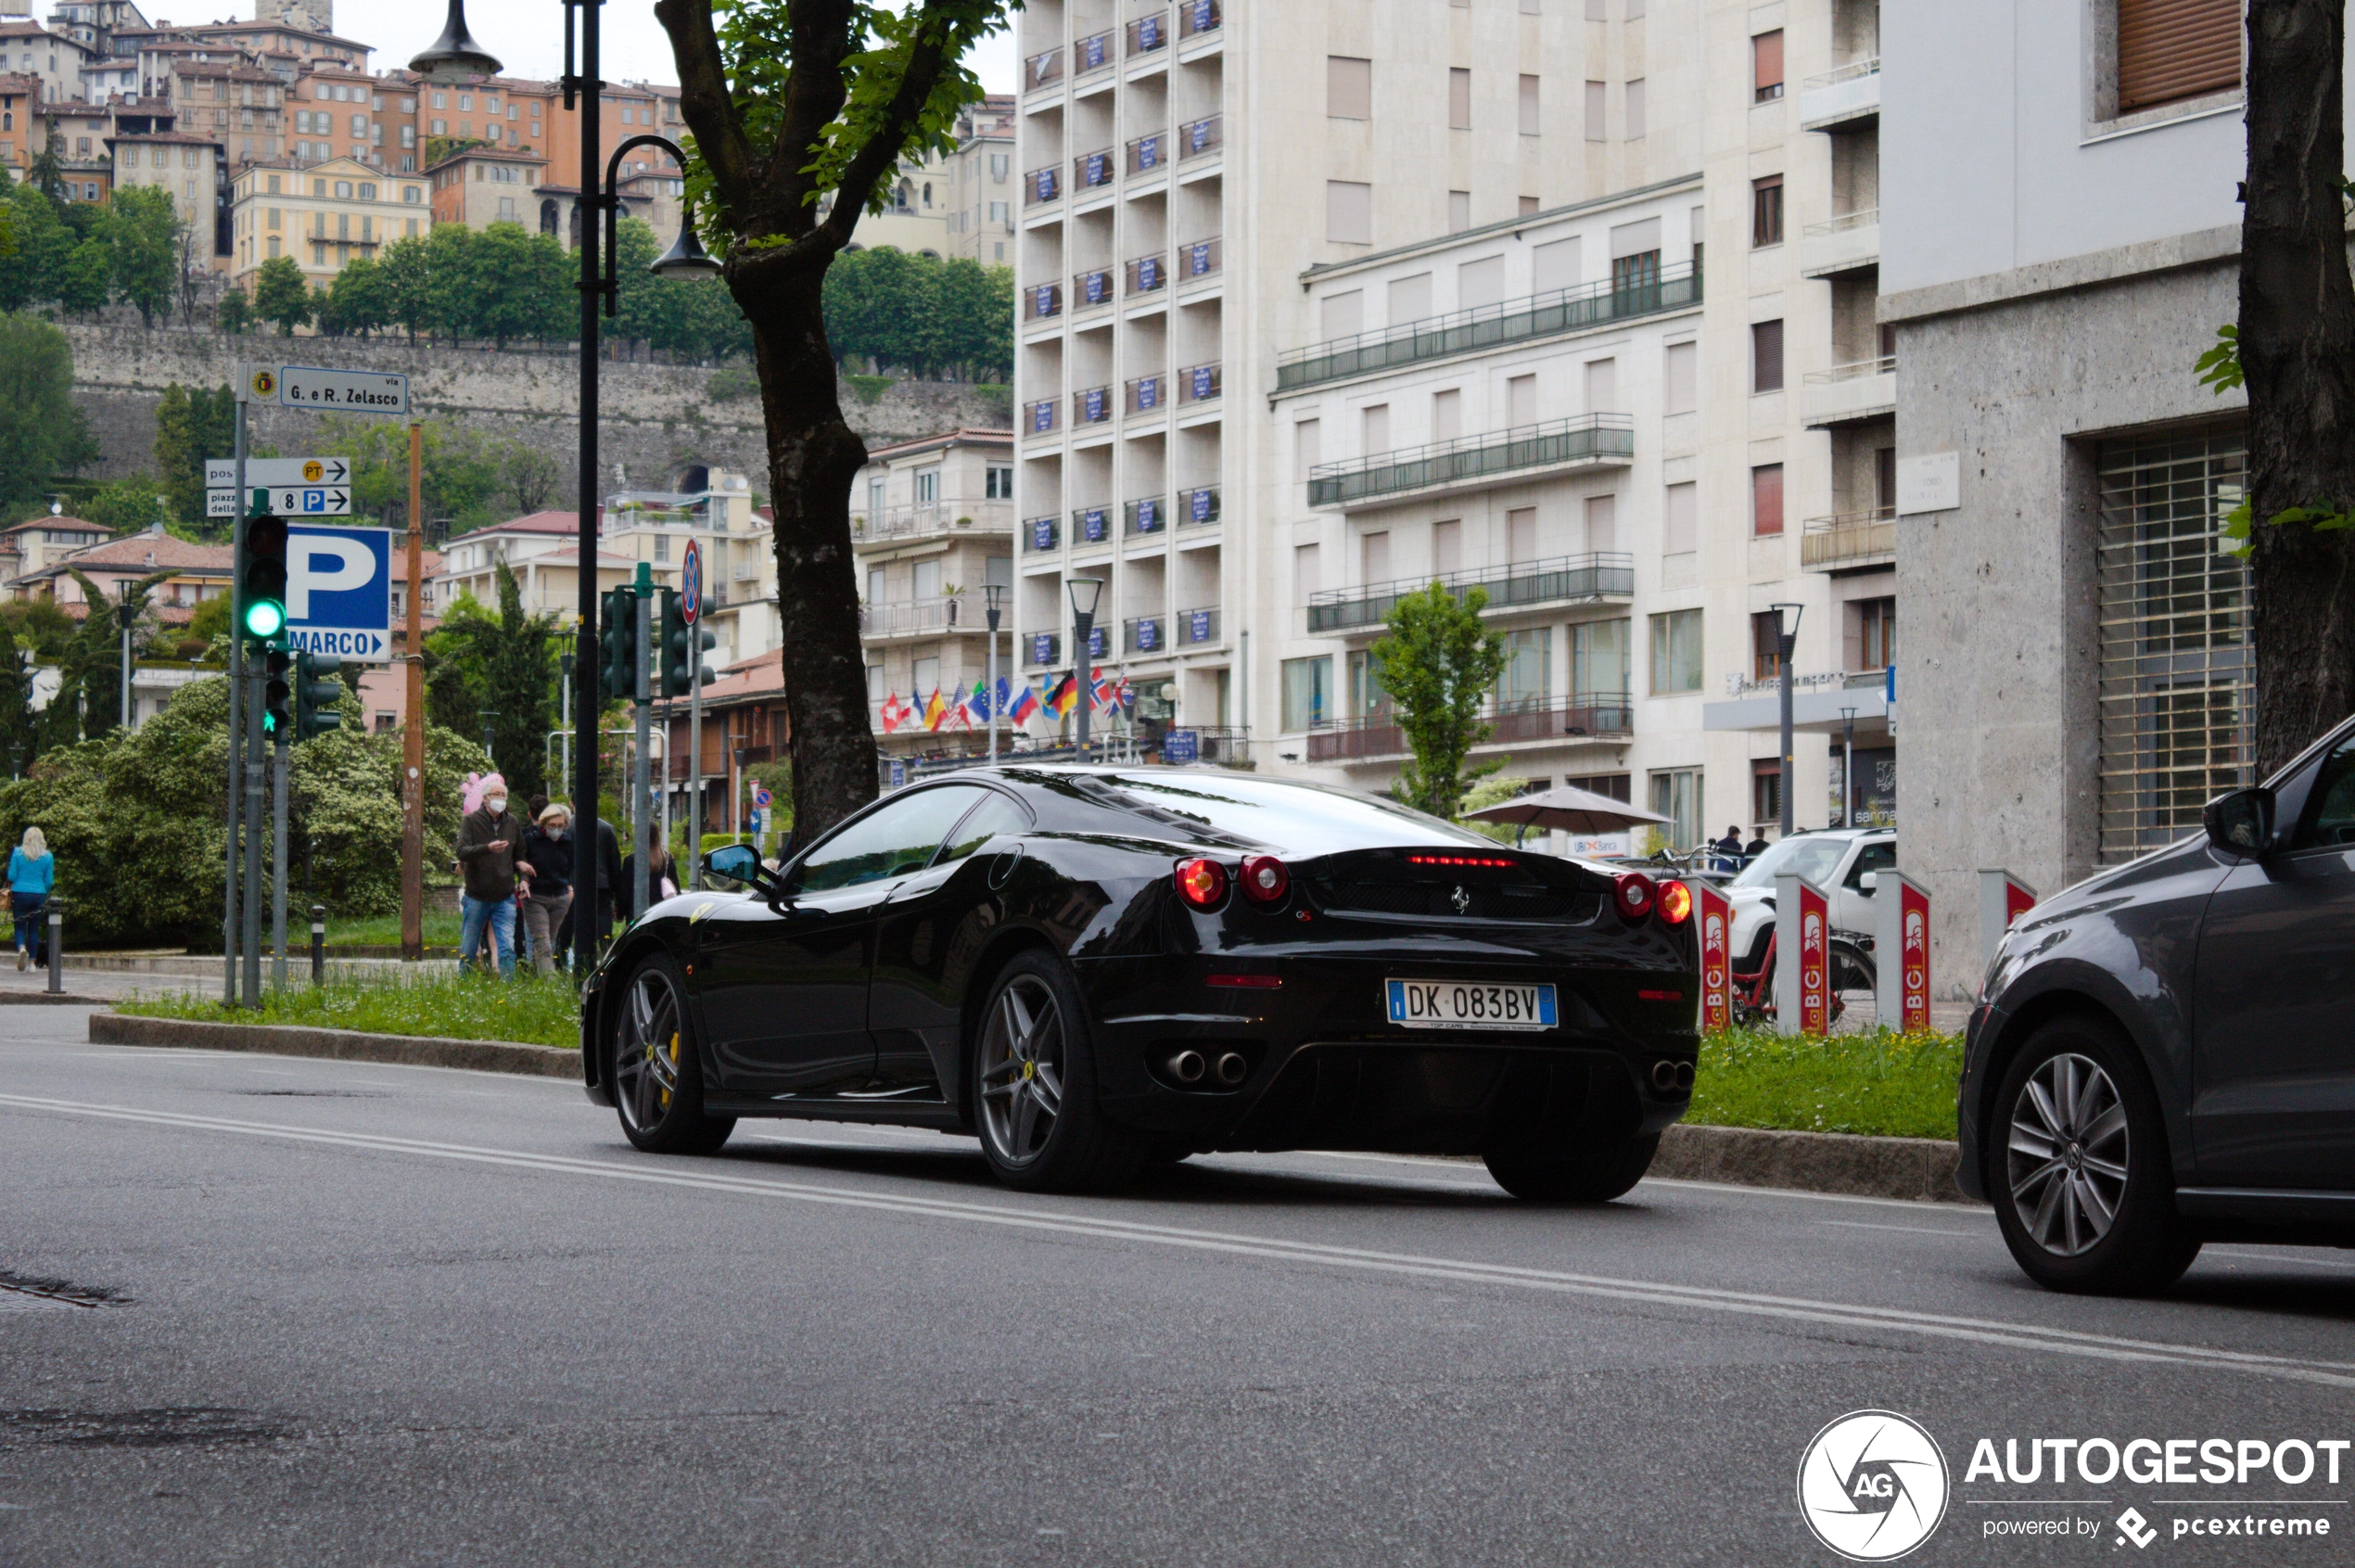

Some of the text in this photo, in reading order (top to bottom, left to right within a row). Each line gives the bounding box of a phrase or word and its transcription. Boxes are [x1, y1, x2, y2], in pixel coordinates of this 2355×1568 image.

[291, 385, 305, 400] G.
[312, 390, 319, 401] e
[325, 389, 340, 402] R.
[347, 389, 399, 405] Zelasco
[305, 467, 322, 477] PT
[211, 492, 245, 504] piazz
[286, 494, 294, 509] 8
[307, 492, 320, 509] P
[211, 504, 236, 513] della
[286, 534, 376, 619] P
[289, 631, 367, 655] MARCO
[1574, 841, 1617, 853] UBI Banca
[1408, 986, 1442, 1017] DK
[1453, 988, 1535, 1020] 083BV
